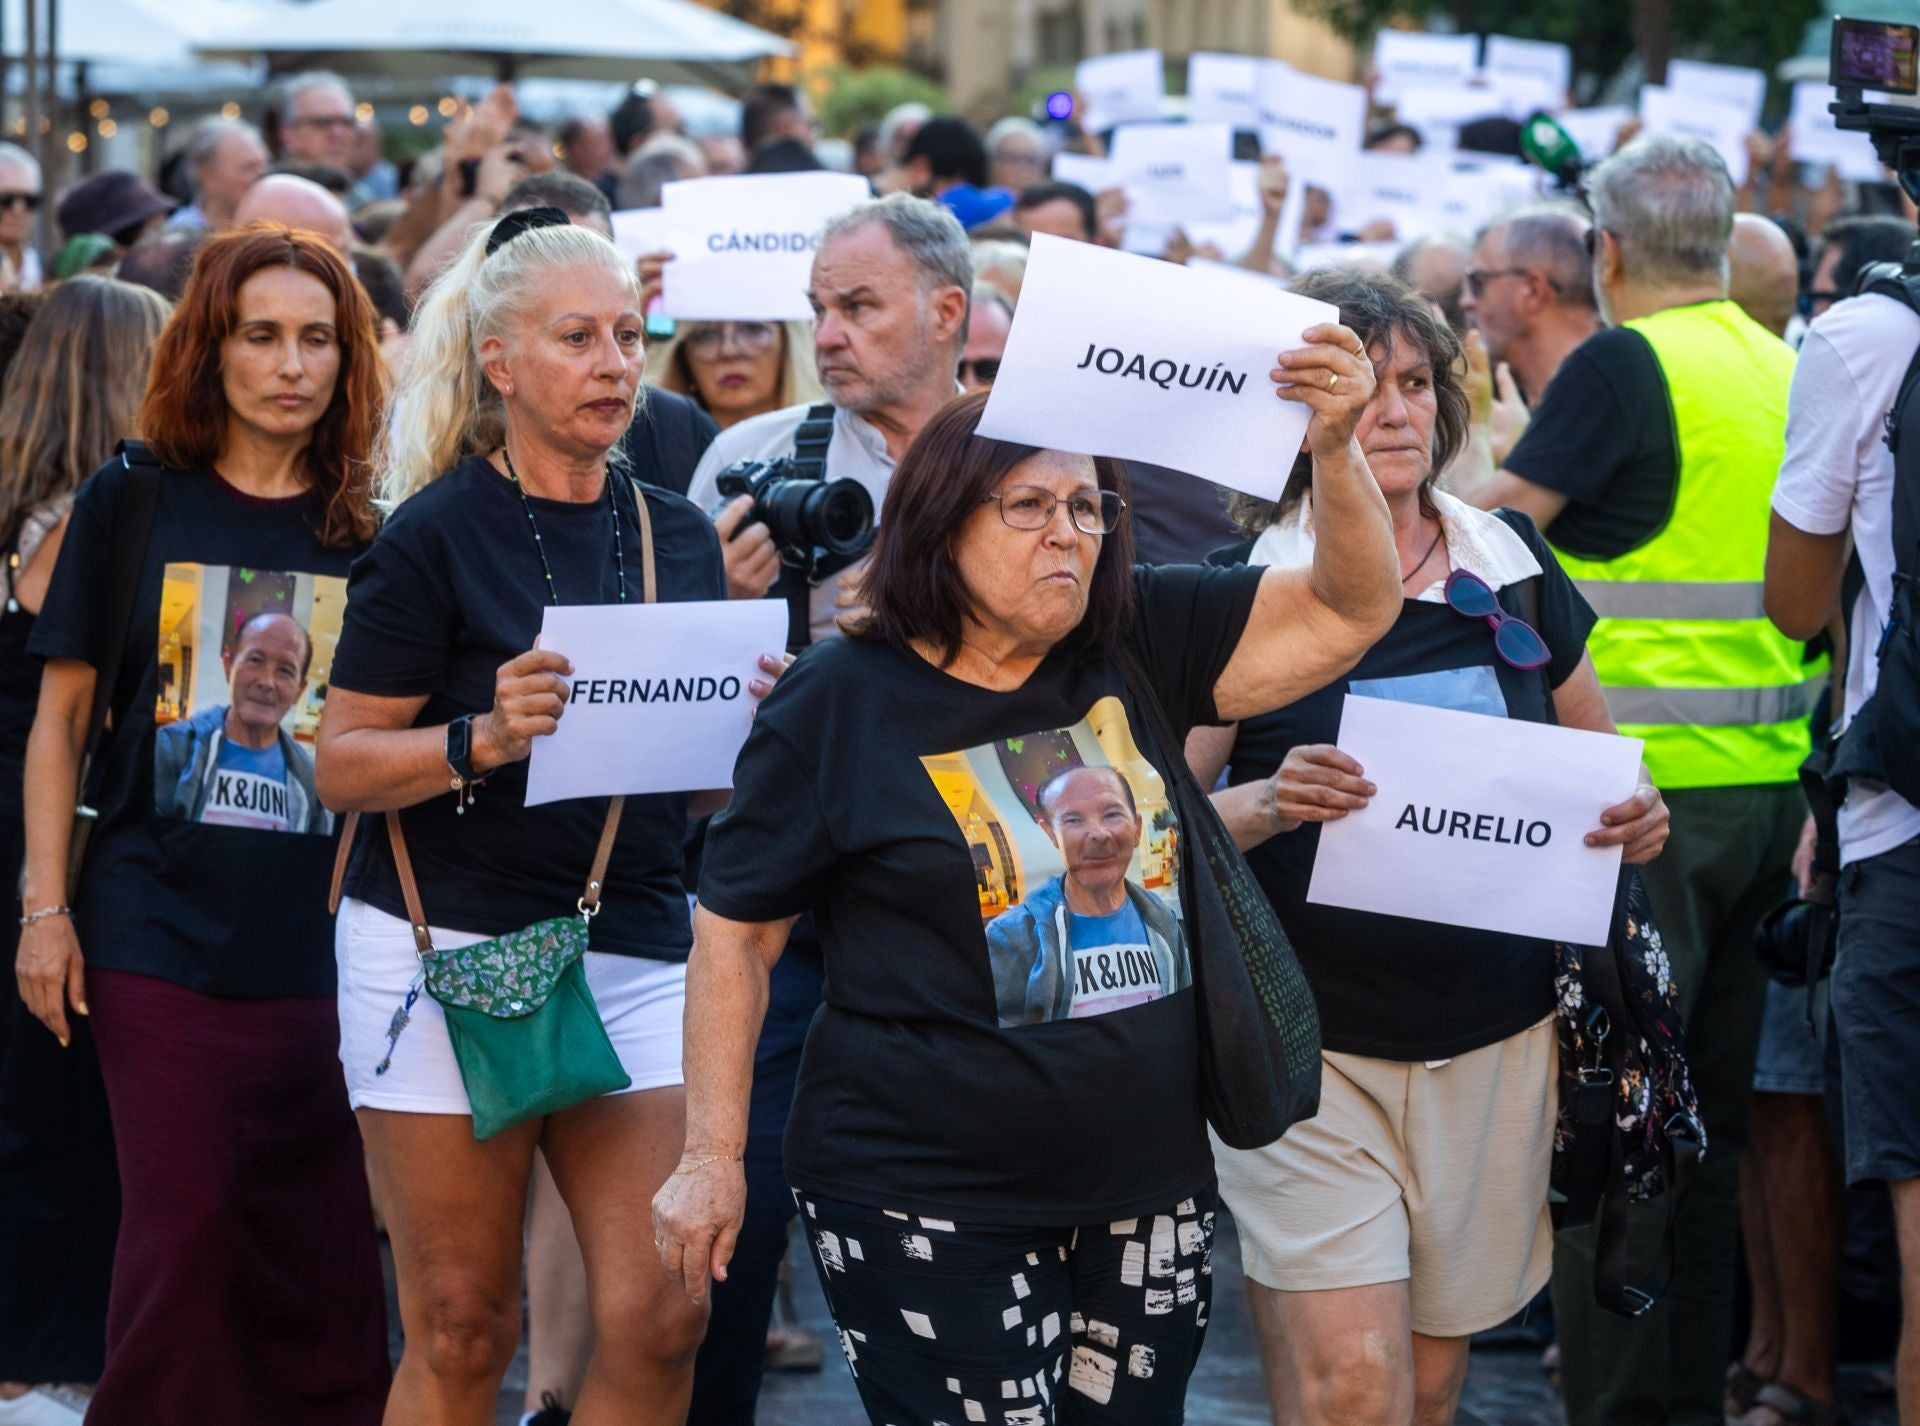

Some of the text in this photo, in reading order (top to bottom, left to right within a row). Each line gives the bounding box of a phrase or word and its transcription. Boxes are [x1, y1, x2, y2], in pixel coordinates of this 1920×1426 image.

[1077, 343, 1248, 395] JOAQUÍN
[570, 676, 741, 705] FERNANDO
[209, 775, 289, 820] K&JON
[1395, 803, 1552, 847] AURELIO
[1074, 949, 1160, 996] K&JON
